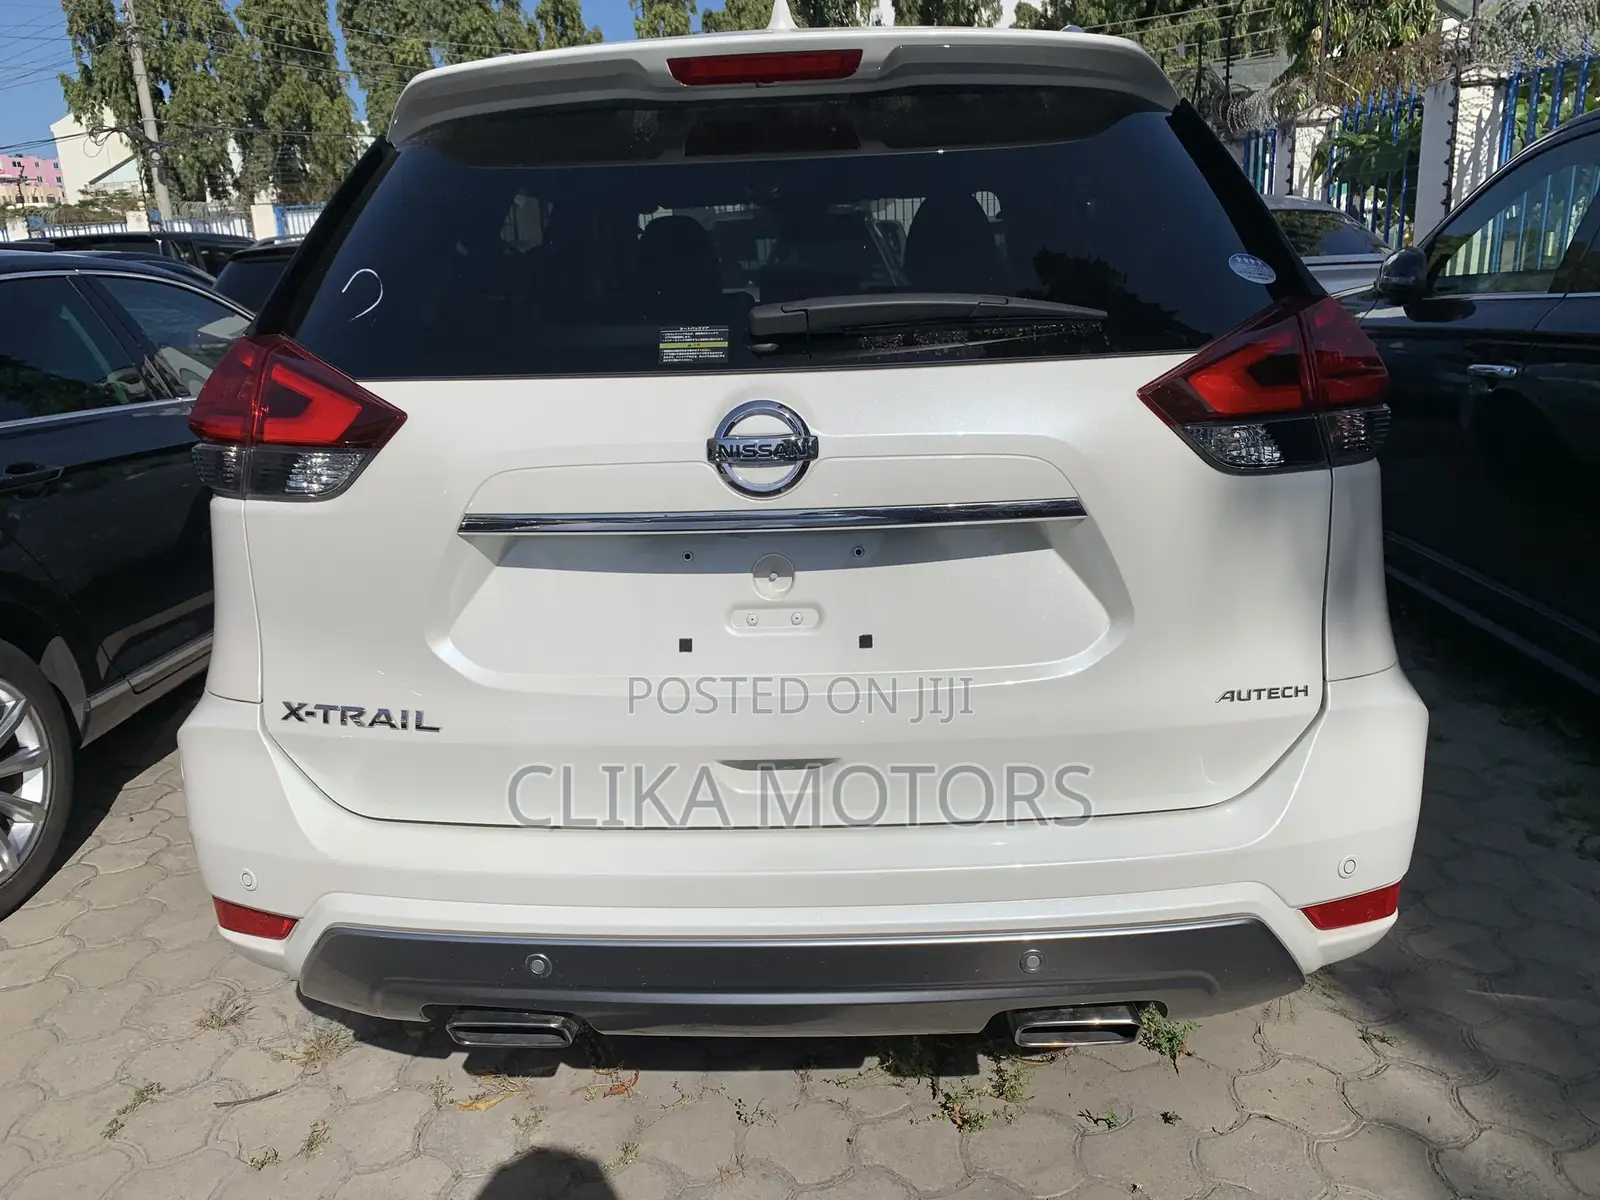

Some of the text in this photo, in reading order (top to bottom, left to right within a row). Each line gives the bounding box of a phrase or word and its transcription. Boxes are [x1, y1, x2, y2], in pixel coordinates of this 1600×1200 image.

[718, 440, 809, 459] NISSAN
[1215, 685, 1308, 703] AUTECH
[281, 701, 443, 733] X-TRAIL
